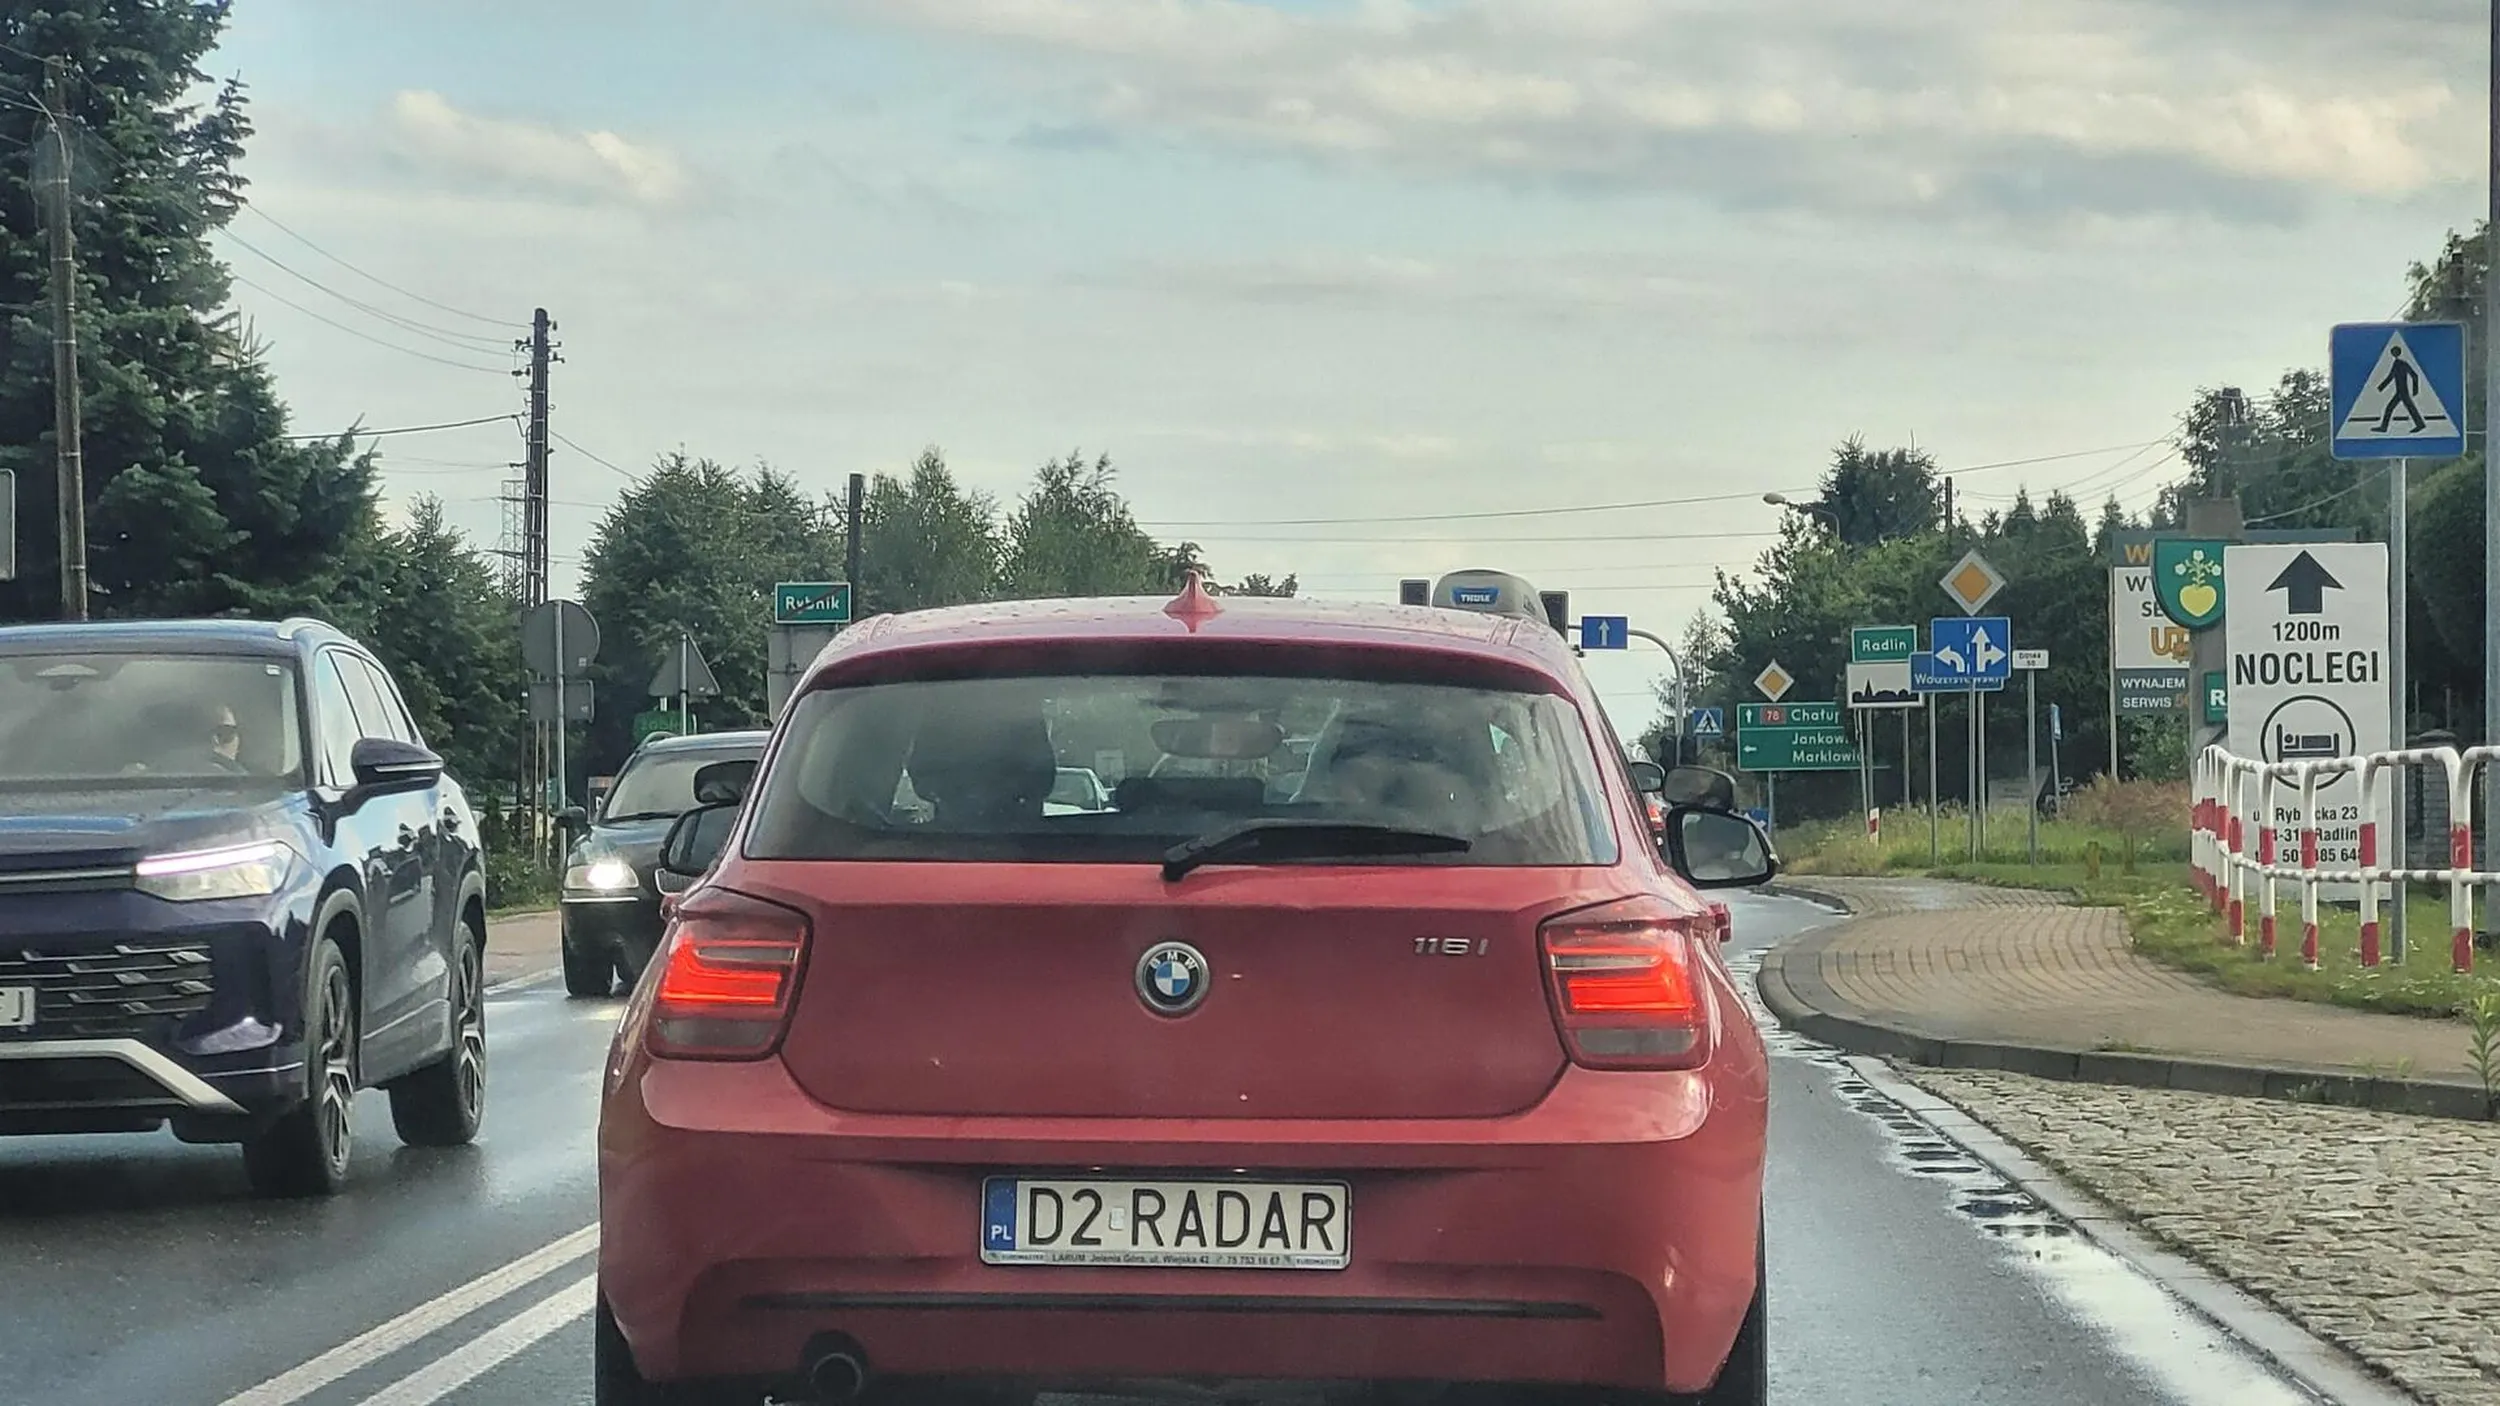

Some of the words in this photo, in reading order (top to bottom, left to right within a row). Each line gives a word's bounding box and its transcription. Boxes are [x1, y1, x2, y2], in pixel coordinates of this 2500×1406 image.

[785, 595, 840, 614] Rybnik
[2272, 621, 2340, 641] 1200m
[1862, 638, 1907, 652] Radlin
[2235, 651, 2378, 685] NOCLEGI
[2121, 677, 2186, 689] WYNAJEM
[2122, 696, 2172, 709] SERWIS
[1766, 710, 1780, 721] 78
[2275, 806, 2337, 824] Rybcka
[2341, 806, 2358, 820] 23
[1149, 950, 1199, 970] BMW
[1028, 1187, 1103, 1246] D2
[1131, 1188, 1337, 1251] RADAR
[991, 1224, 1013, 1240] PL
